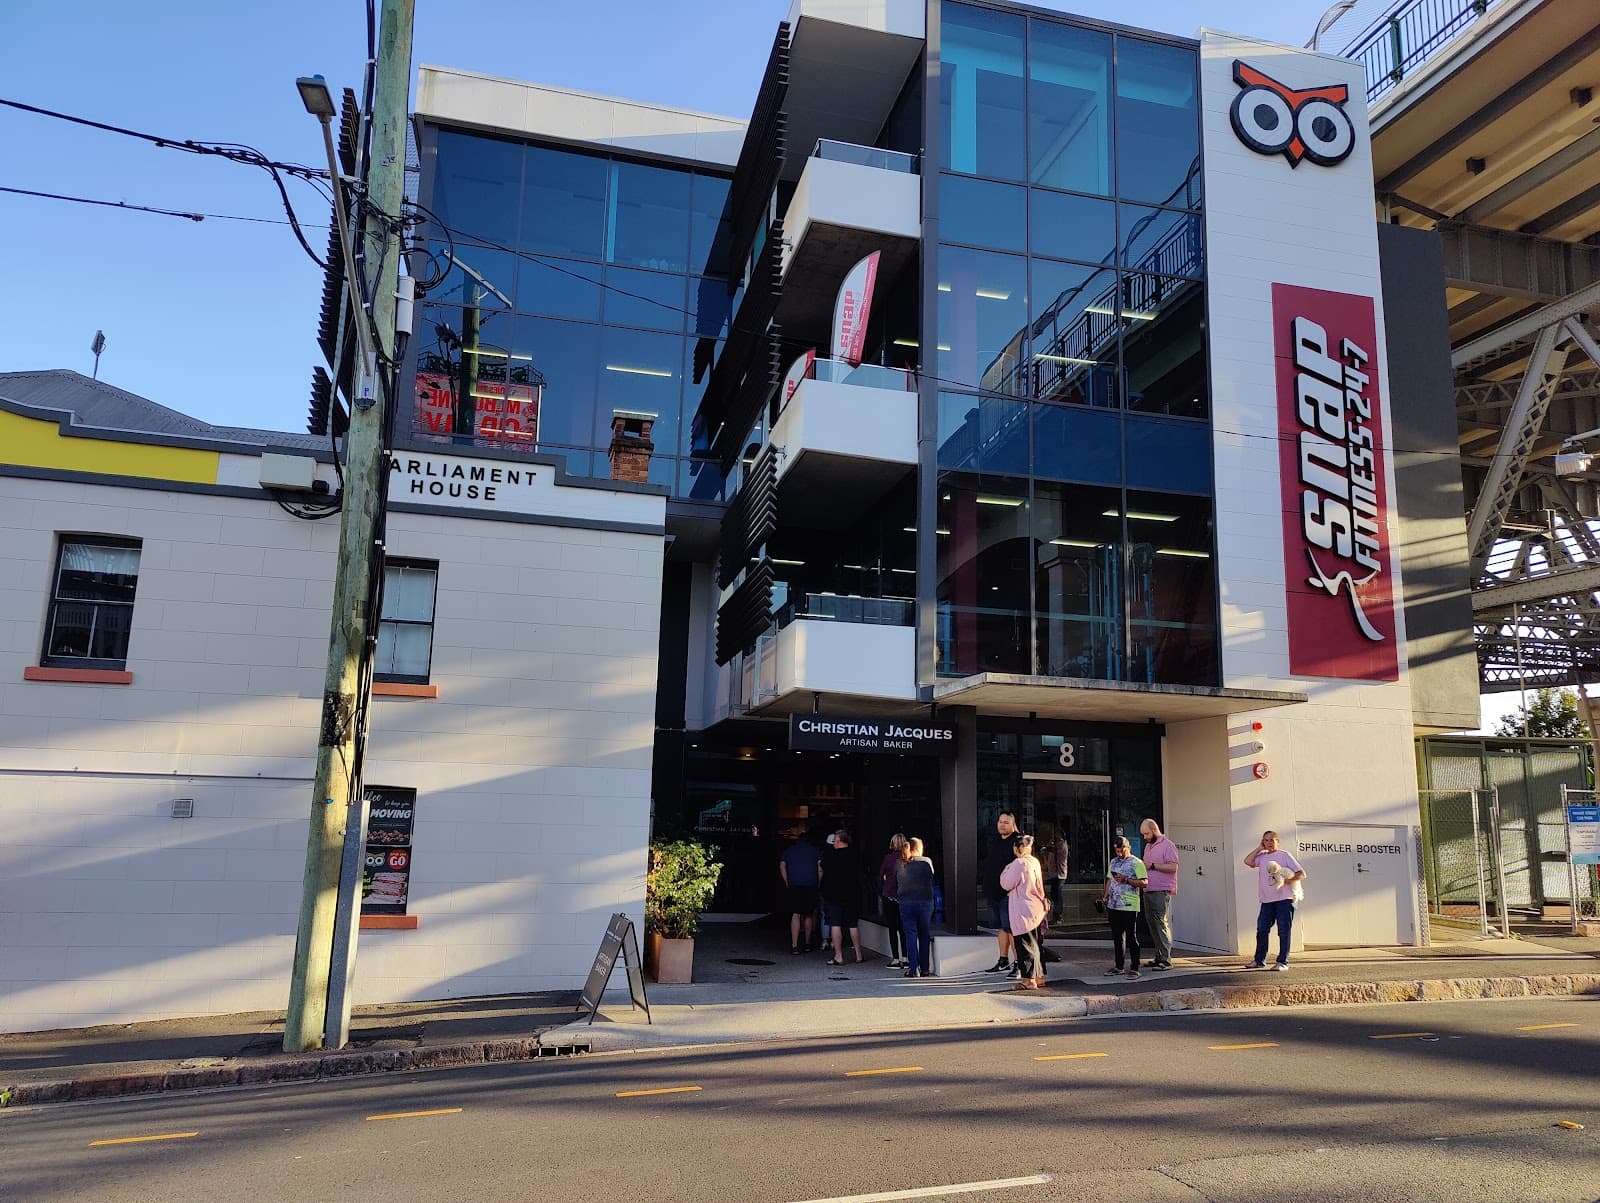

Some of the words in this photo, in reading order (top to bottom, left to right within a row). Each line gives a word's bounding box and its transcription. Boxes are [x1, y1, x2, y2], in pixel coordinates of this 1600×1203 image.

[390, 458, 537, 486] ARLIAMENT
[410, 479, 496, 500] HOUSE
[798, 720, 879, 736] CHRISTIAN
[884, 725, 953, 740] JACQUES
[839, 738, 878, 748] ARTISAN
[883, 740, 913, 749] BAKER
[1059, 742, 1075, 767] 8
[370, 808, 412, 819] MOVING
[1299, 842, 1352, 853] SPRINKLER
[1356, 844, 1401, 855] BOOSTER
[389, 856, 406, 865] GO
